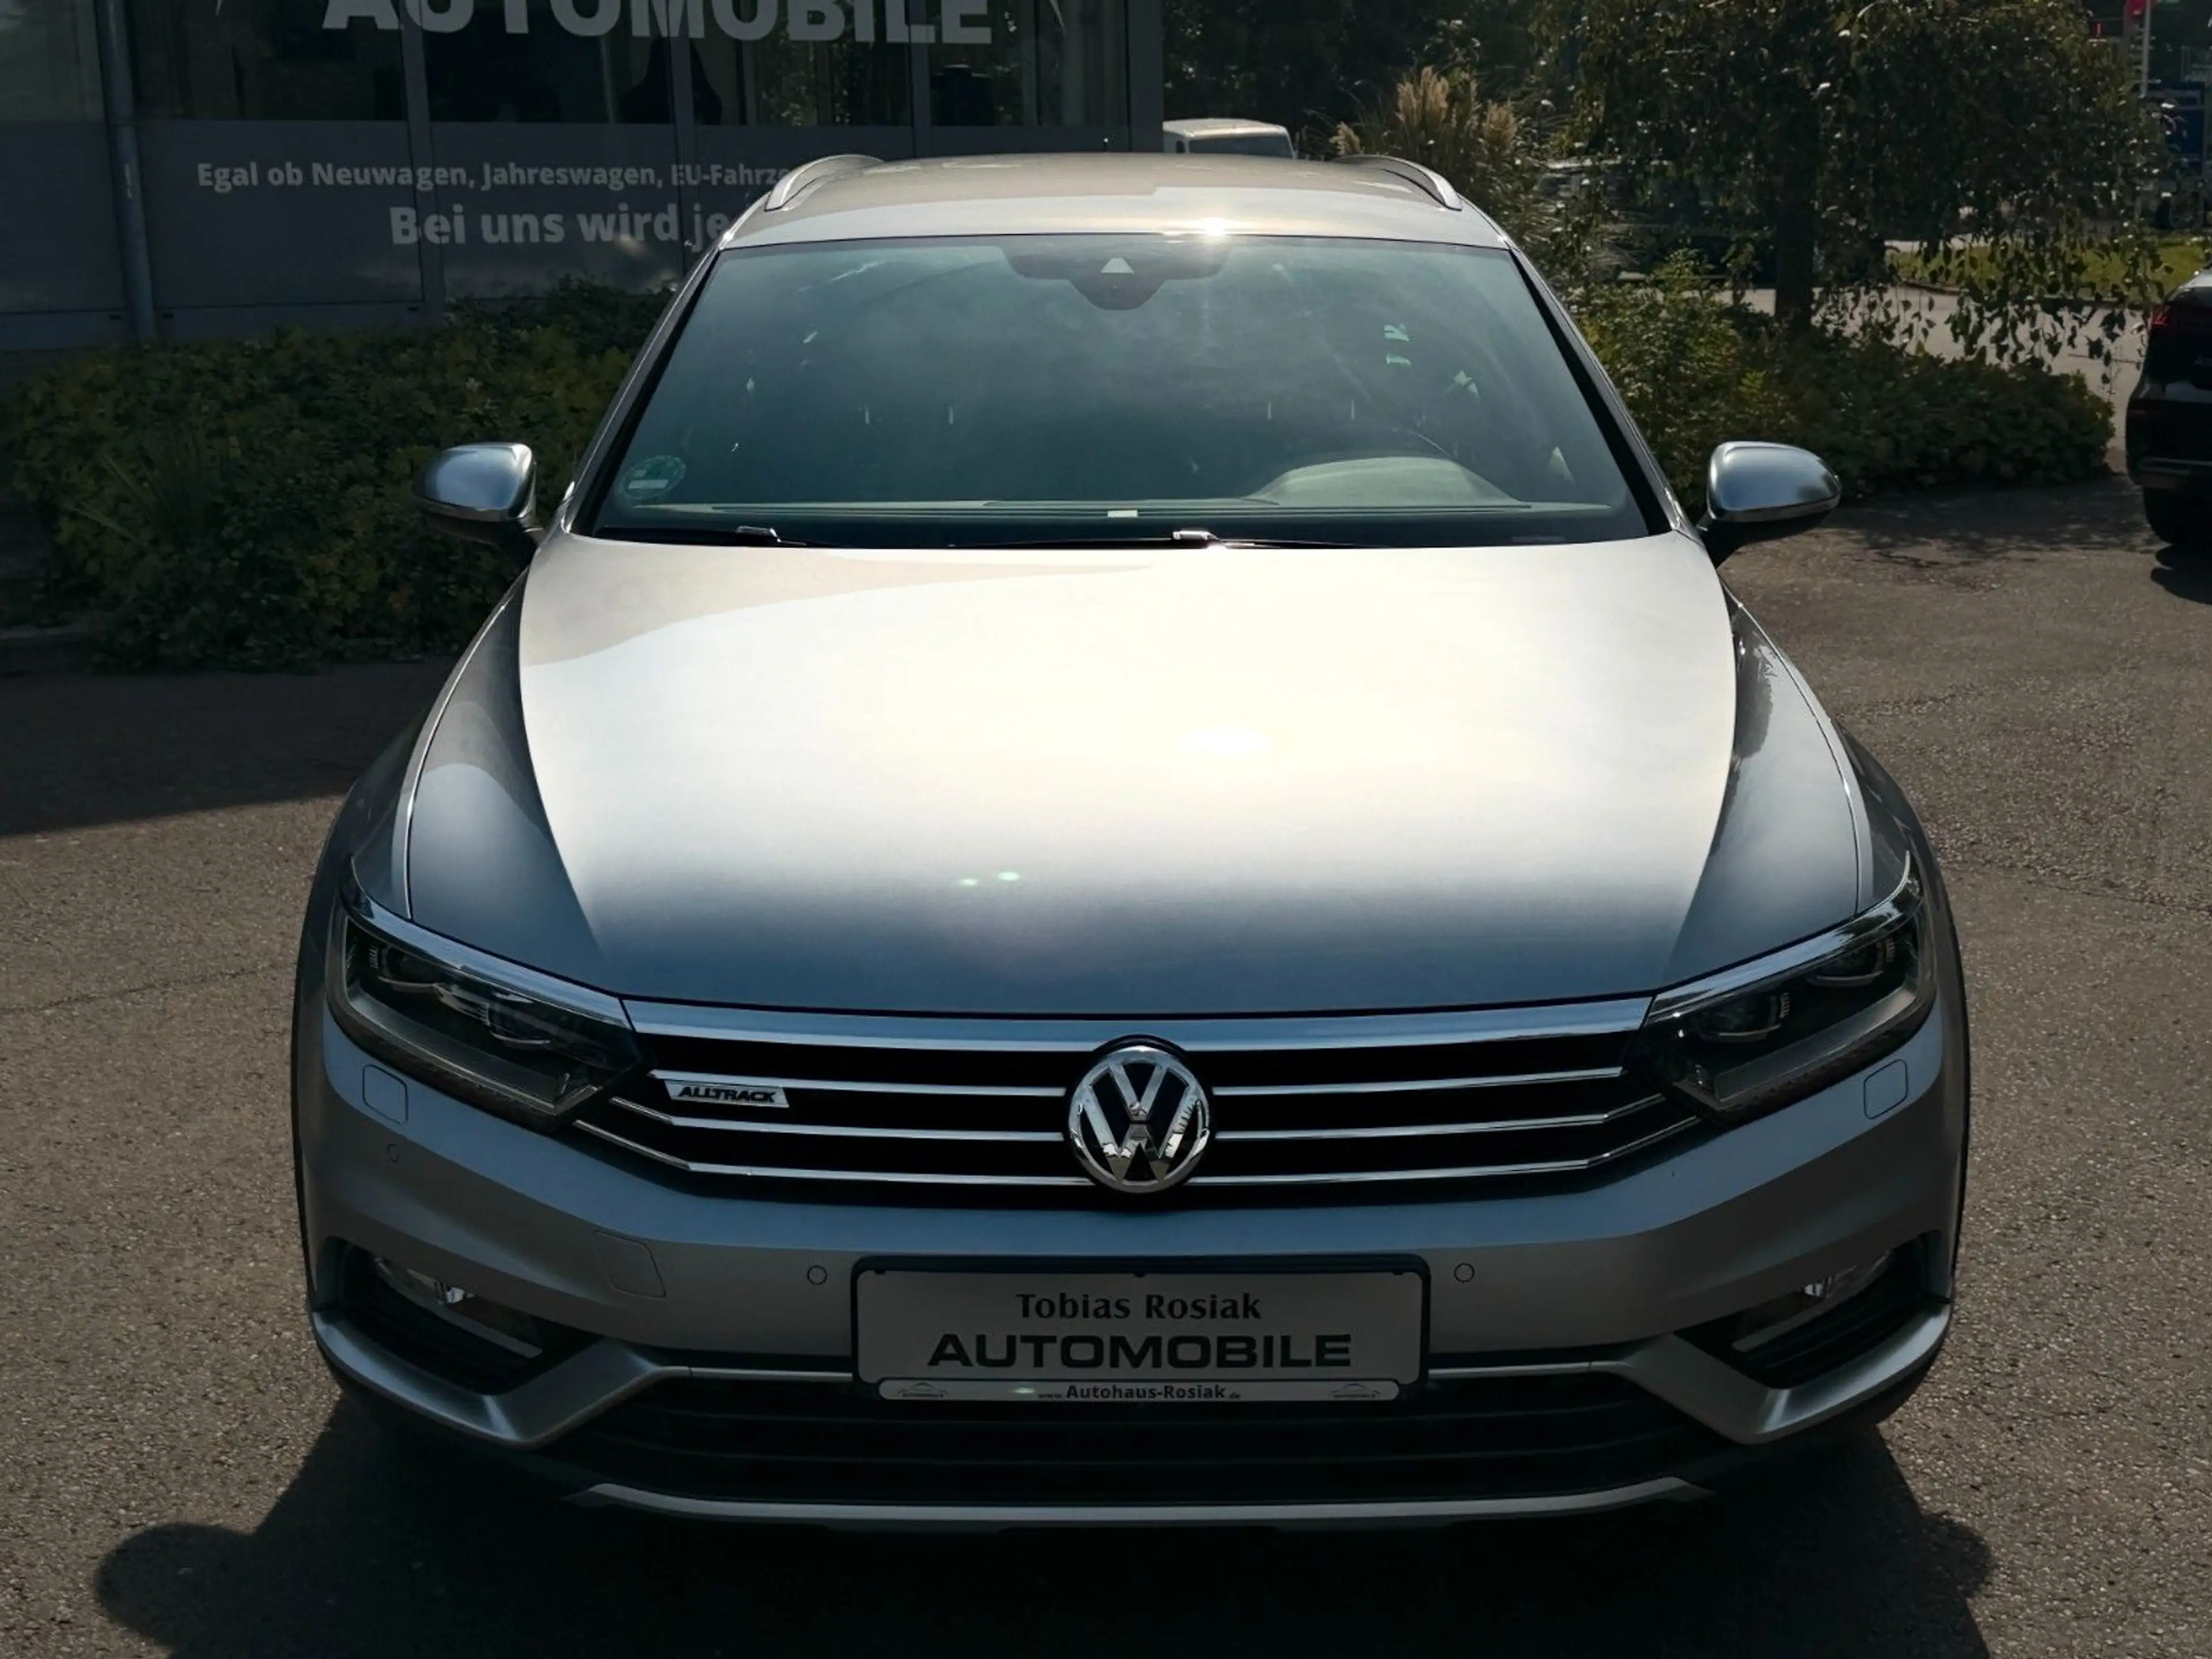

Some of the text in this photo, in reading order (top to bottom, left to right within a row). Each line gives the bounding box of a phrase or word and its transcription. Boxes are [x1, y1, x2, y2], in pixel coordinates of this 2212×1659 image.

[196, 161, 258, 193] Egal
[267, 161, 303, 186] ob
[312, 162, 475, 191] Neuwagen,
[480, 162, 662, 191] Jahreswagen,
[390, 203, 466, 244] Bei
[480, 212, 566, 244] uns
[577, 202, 679, 242] wird
[679, 1086, 776, 1103] ALLTRACK
[1016, 1292, 1263, 1319] Tobias Rosiak
[927, 1333, 1351, 1369] AUTOMOBILE
